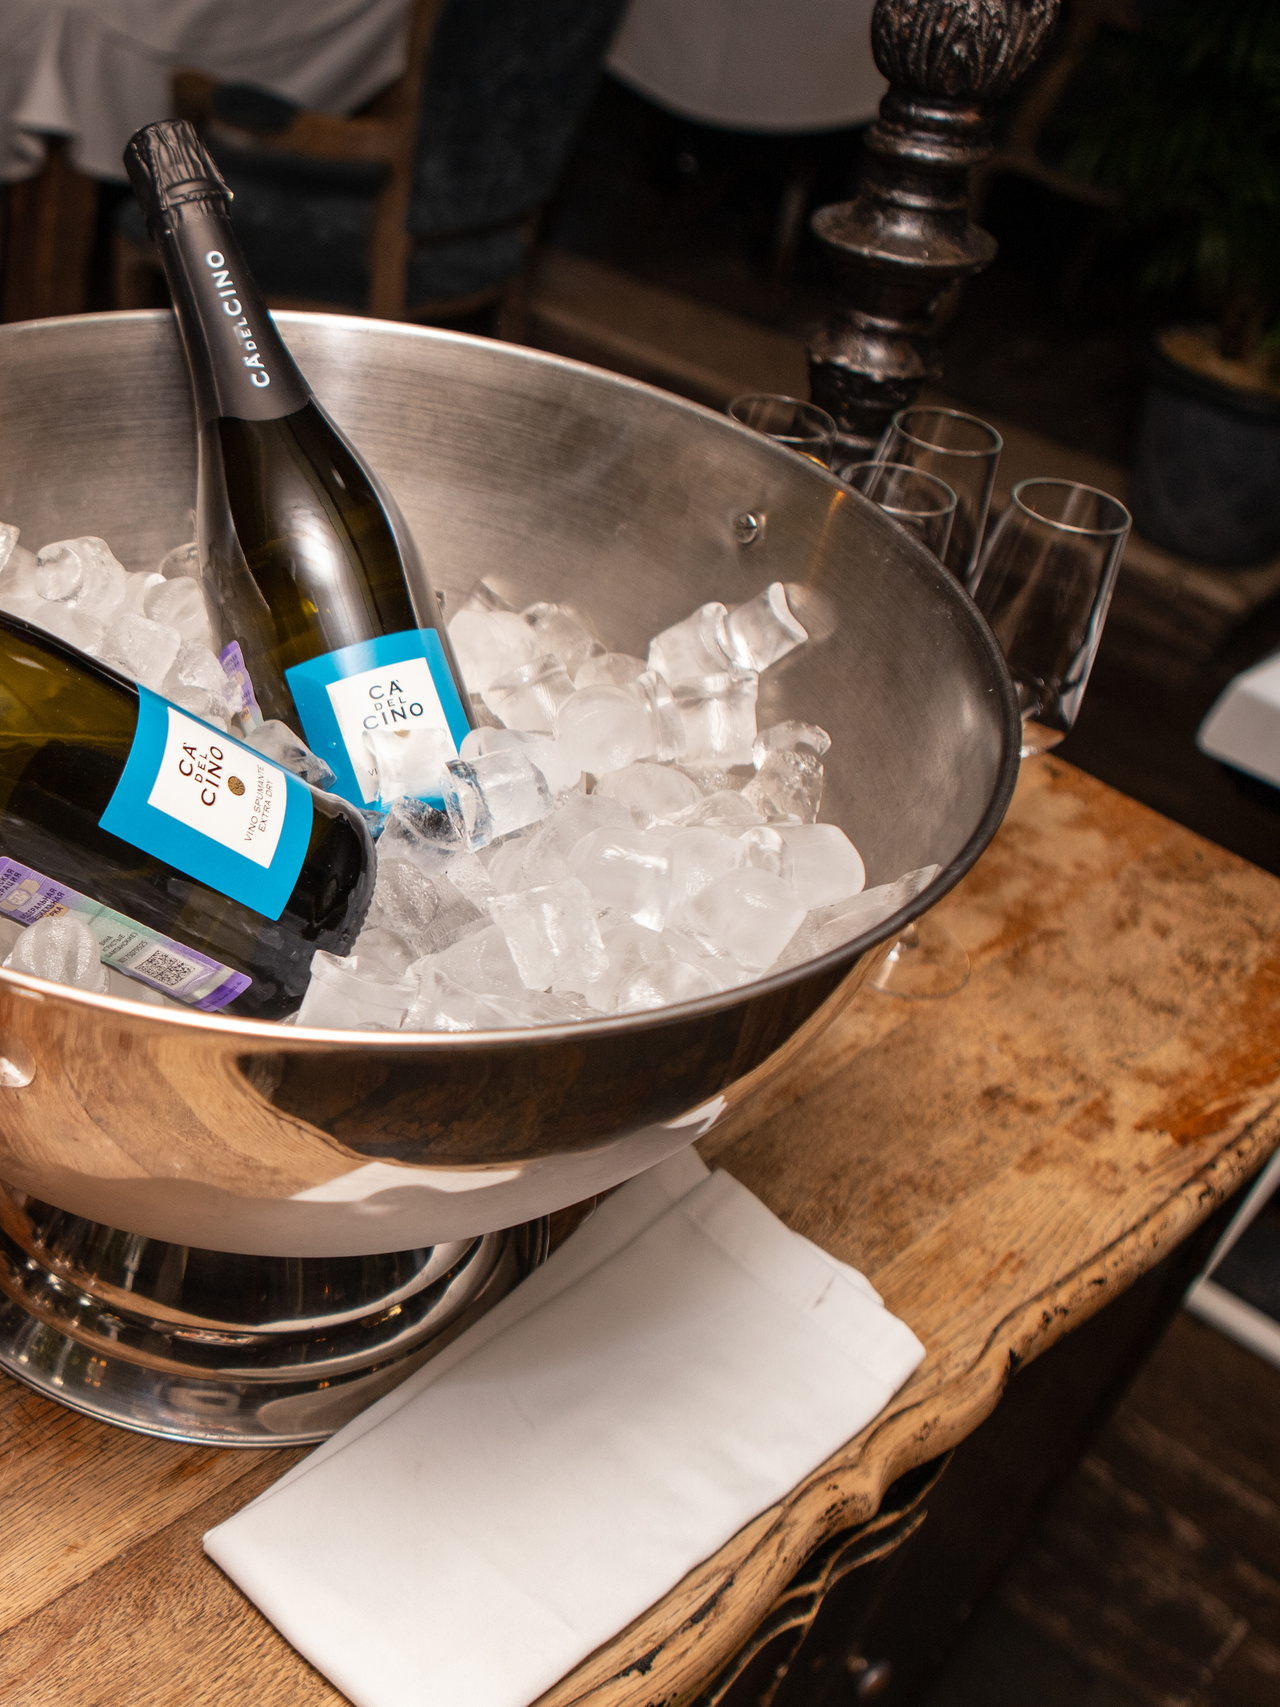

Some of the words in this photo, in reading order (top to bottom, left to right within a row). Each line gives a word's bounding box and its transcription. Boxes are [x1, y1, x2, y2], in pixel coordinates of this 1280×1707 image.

[205, 250, 243, 316] CINO
[237, 316, 258, 351] DEL
[363, 702, 424, 730] CINO
[374, 696, 406, 711] DEL
[194, 752, 208, 783] DEL
[200, 746, 224, 806] CINO
[244, 814, 259, 842] VINO
[253, 764, 265, 813] SPUMANTE
[258, 800, 271, 833] EXTRA
[265, 779, 274, 798] DRY
